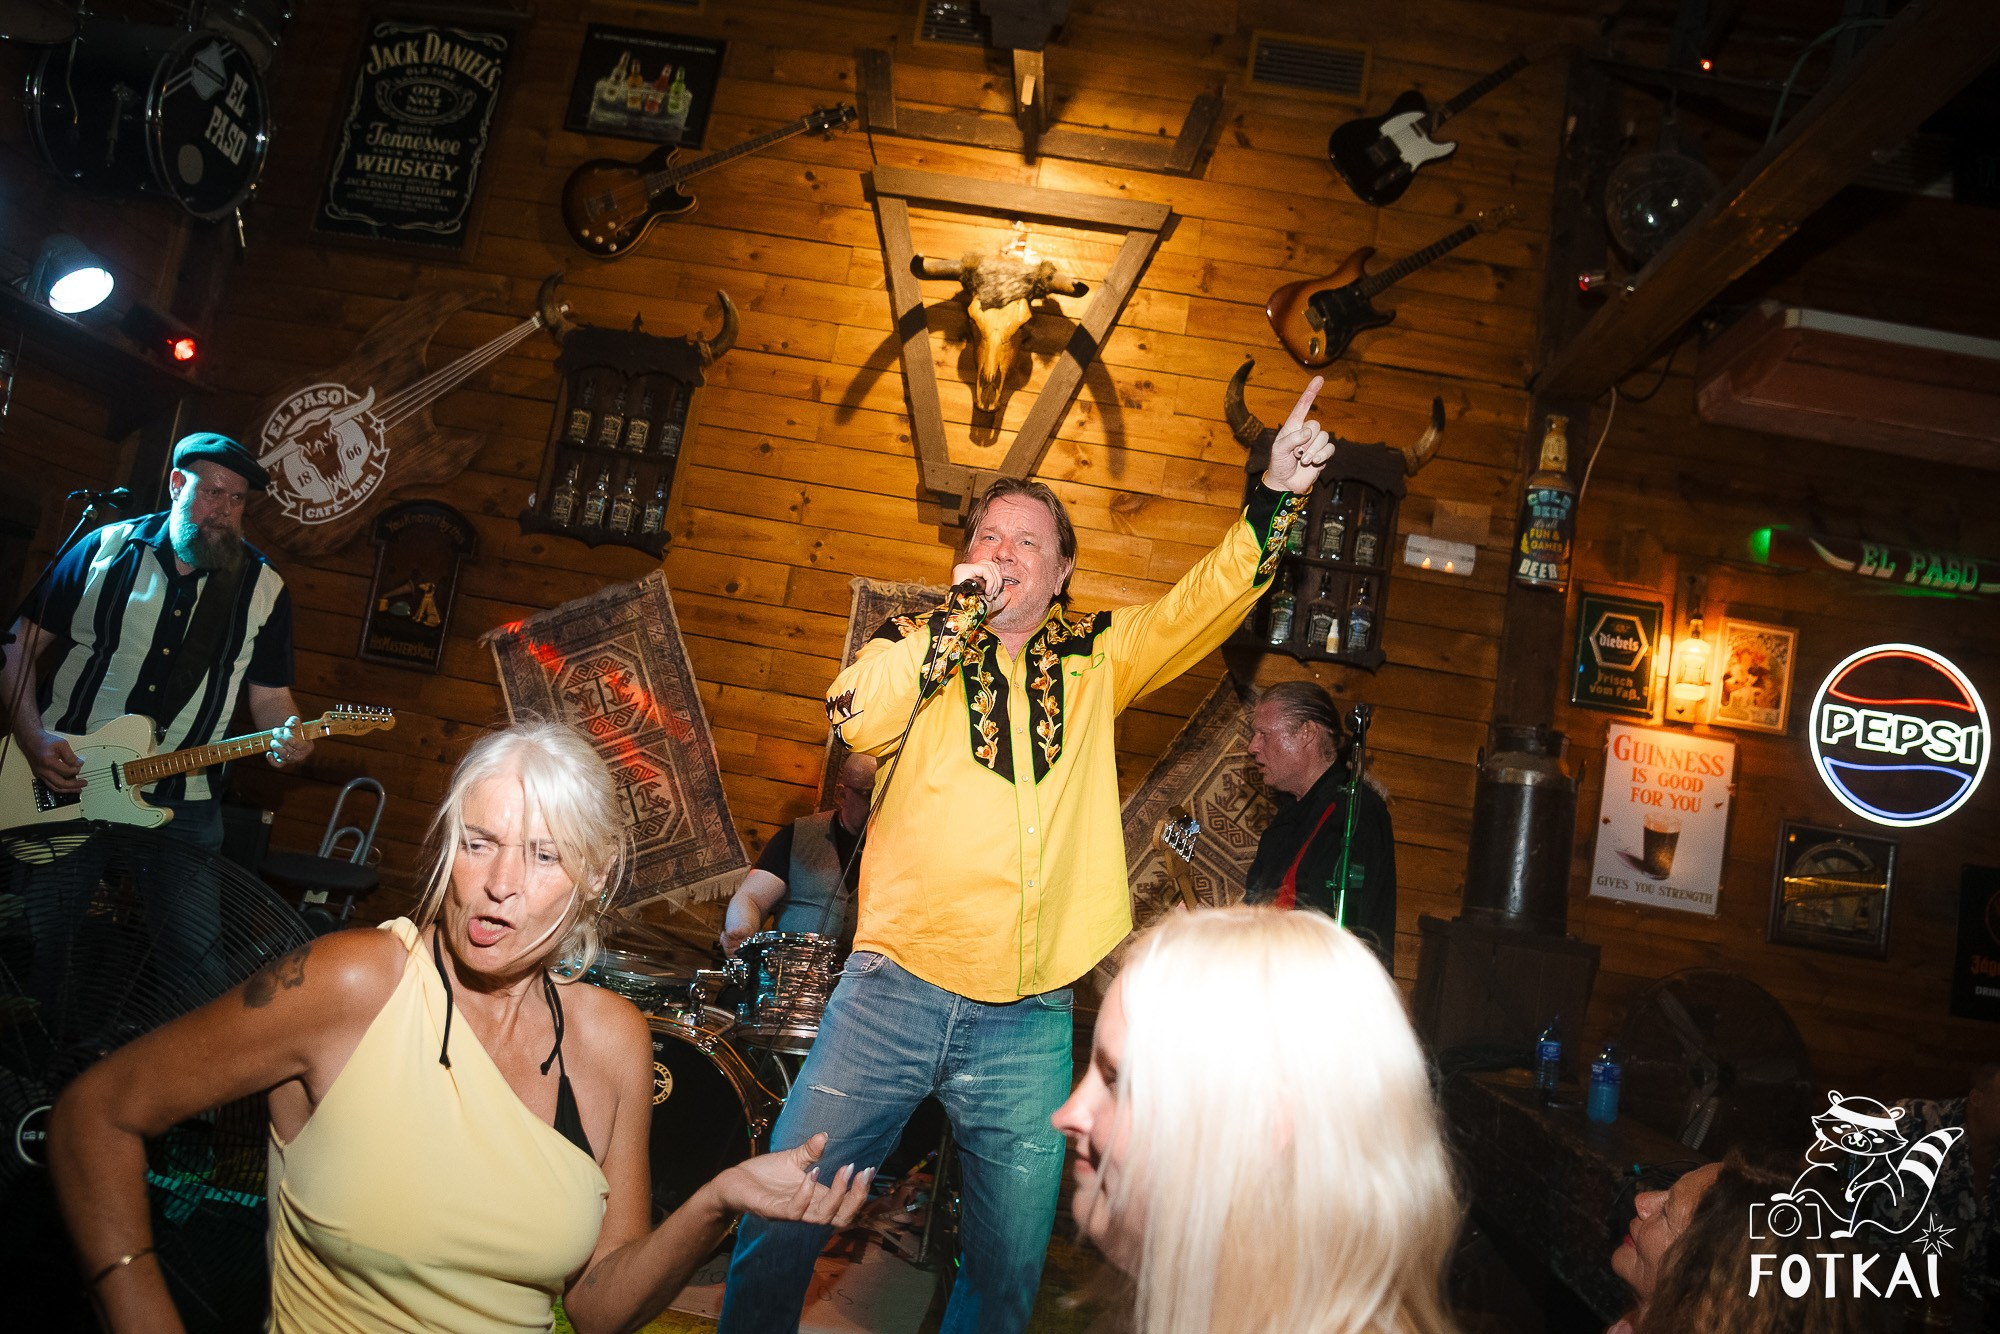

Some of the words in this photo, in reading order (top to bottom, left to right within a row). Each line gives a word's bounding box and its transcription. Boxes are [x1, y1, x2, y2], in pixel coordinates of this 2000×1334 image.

[367, 39, 420, 75] JACK
[224, 71, 250, 120] EL
[203, 103, 249, 166] PASO
[365, 121, 461, 157] Tennessee
[354, 152, 460, 183] WHISKEY
[267, 411, 293, 440] EL
[289, 388, 343, 416] PASO
[350, 473, 378, 501] BAR
[1526, 489, 1573, 511] COLD
[1532, 504, 1568, 521] BEER
[1529, 527, 1552, 540] FUN
[1517, 557, 1558, 579] BEER
[1856, 542, 1897, 580] EL
[1903, 549, 1980, 593] PASO
[1599, 632, 1640, 653] Diebels
[1821, 703, 1979, 766] PEPSI
[1613, 733, 1725, 777] GUINNESS
[1631, 767, 1647, 784] IS
[1658, 772, 1704, 793] GOOD
[1631, 786, 1662, 807] FOR
[1669, 793, 1702, 814] YOU
[1596, 875, 1629, 891] GIVES
[1635, 880, 1657, 896] YOU
[1659, 884, 1715, 905] STRENGTH
